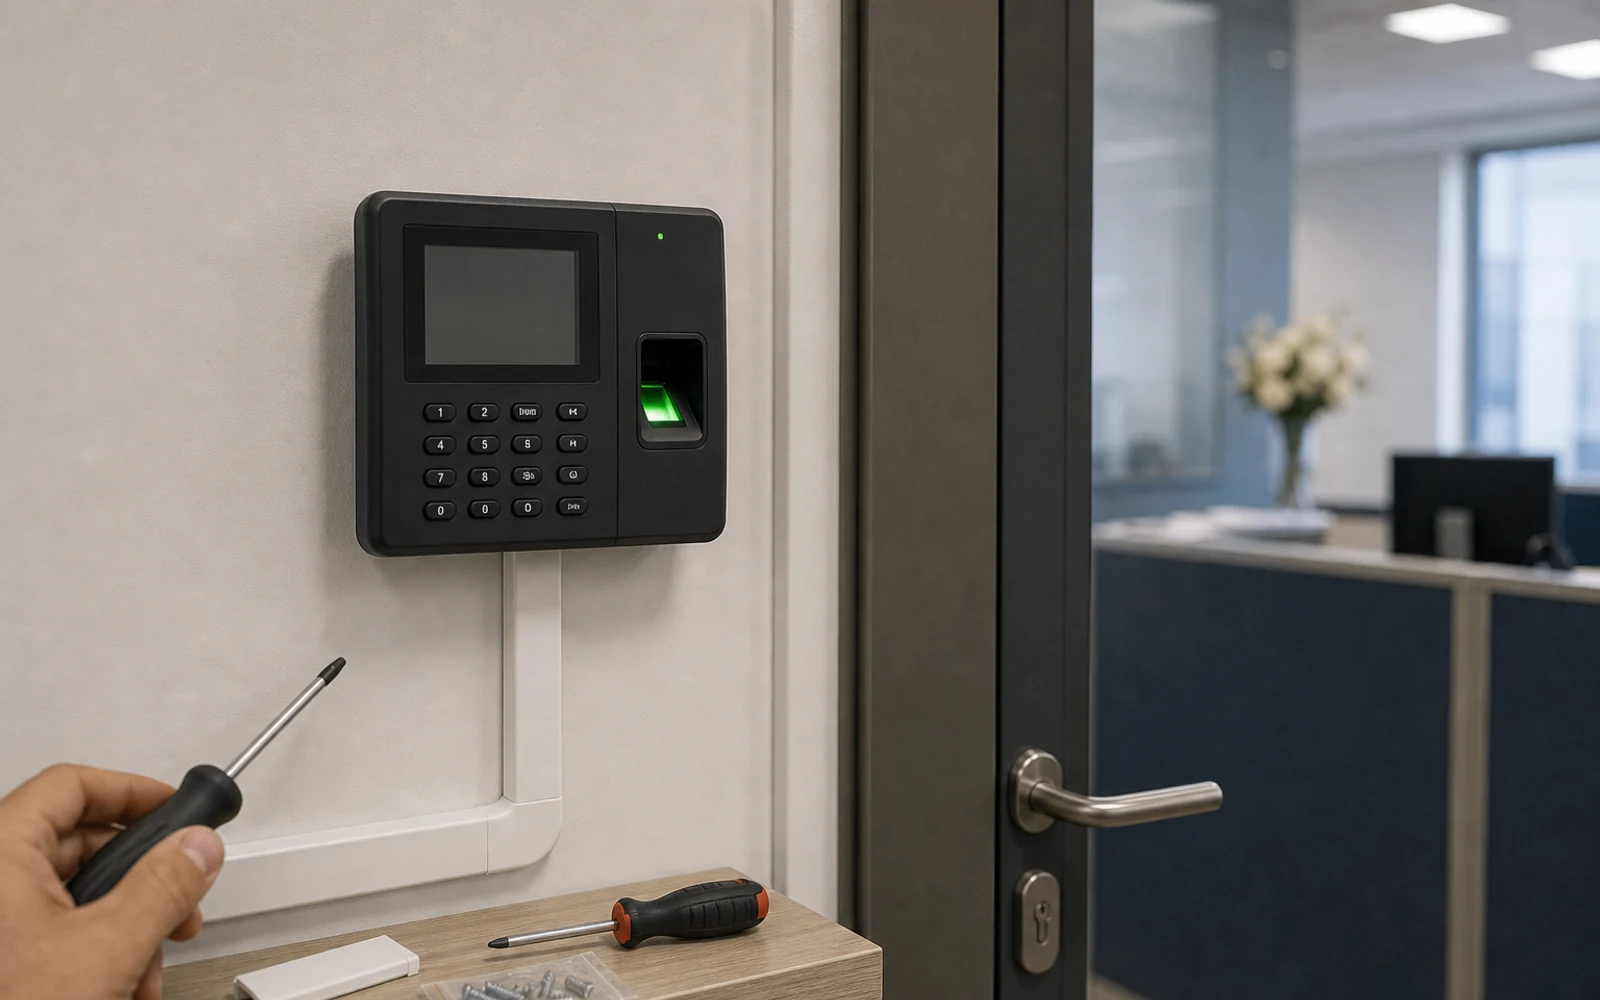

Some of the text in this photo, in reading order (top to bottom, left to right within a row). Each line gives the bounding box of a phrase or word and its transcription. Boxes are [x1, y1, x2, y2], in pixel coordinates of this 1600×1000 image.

[437, 407, 443, 418] 1
[481, 407, 488, 417] 2
[437, 439, 444, 450] 4
[481, 439, 488, 450] 5
[437, 472, 444, 483] 7
[481, 471, 488, 482] 8
[437, 505, 444, 516] 0
[481, 504, 489, 514] 0
